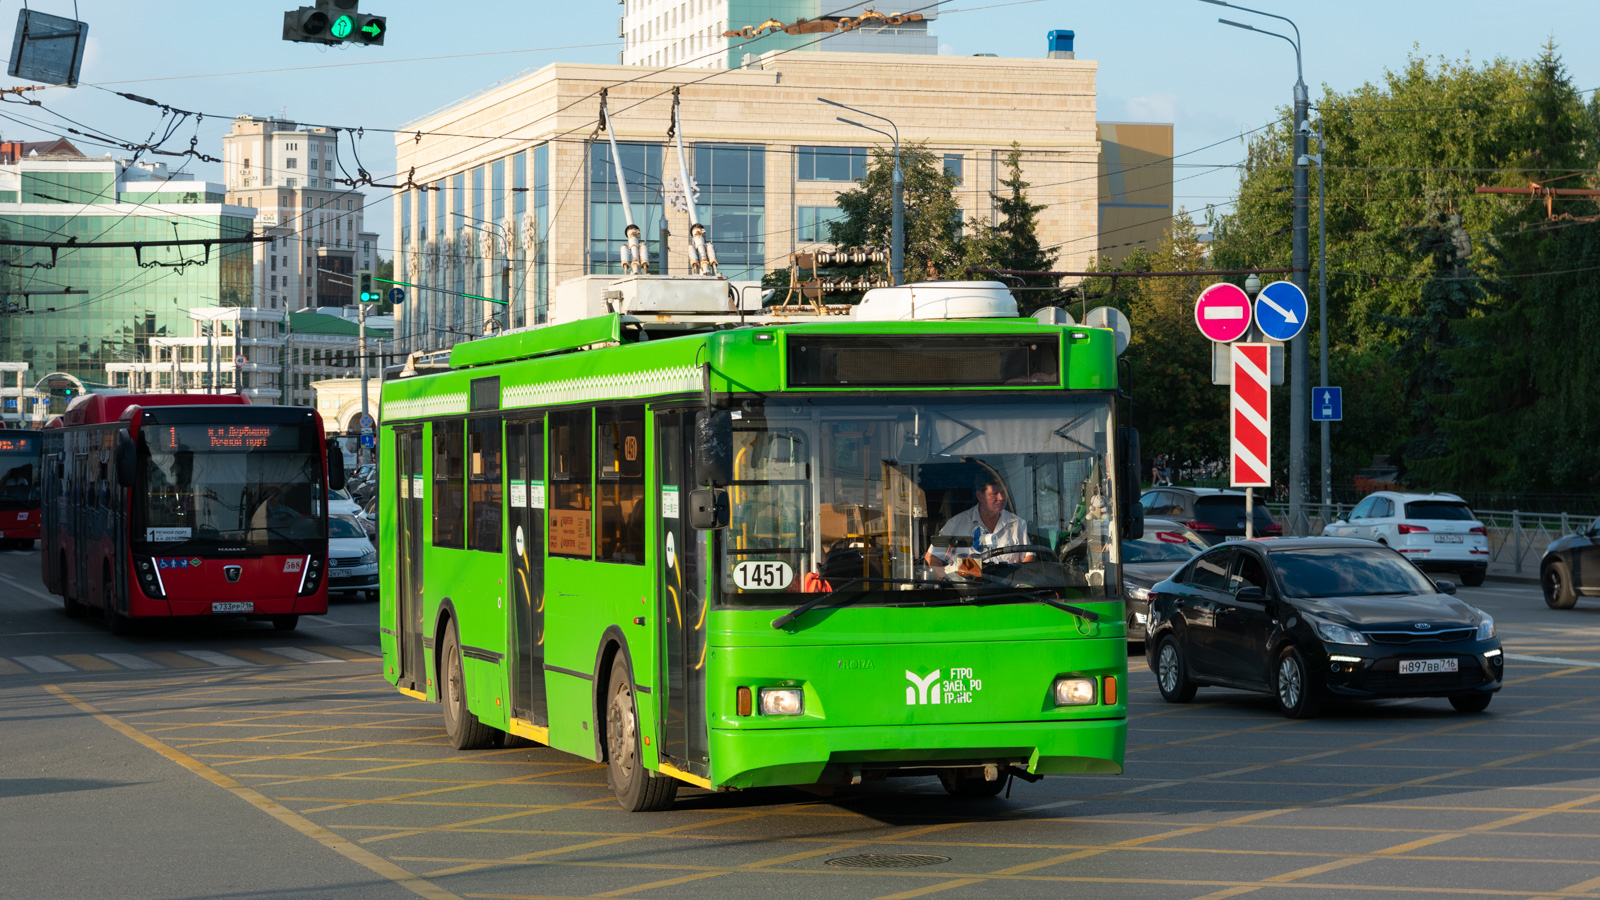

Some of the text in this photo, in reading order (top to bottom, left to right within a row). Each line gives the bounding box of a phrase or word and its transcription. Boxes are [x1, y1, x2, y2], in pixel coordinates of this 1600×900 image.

[169, 427, 178, 447] 1
[211, 436, 267, 447] Речной порт
[149, 529, 155, 542] 1
[286, 562, 300, 570] 568
[739, 564, 784, 587] 1451
